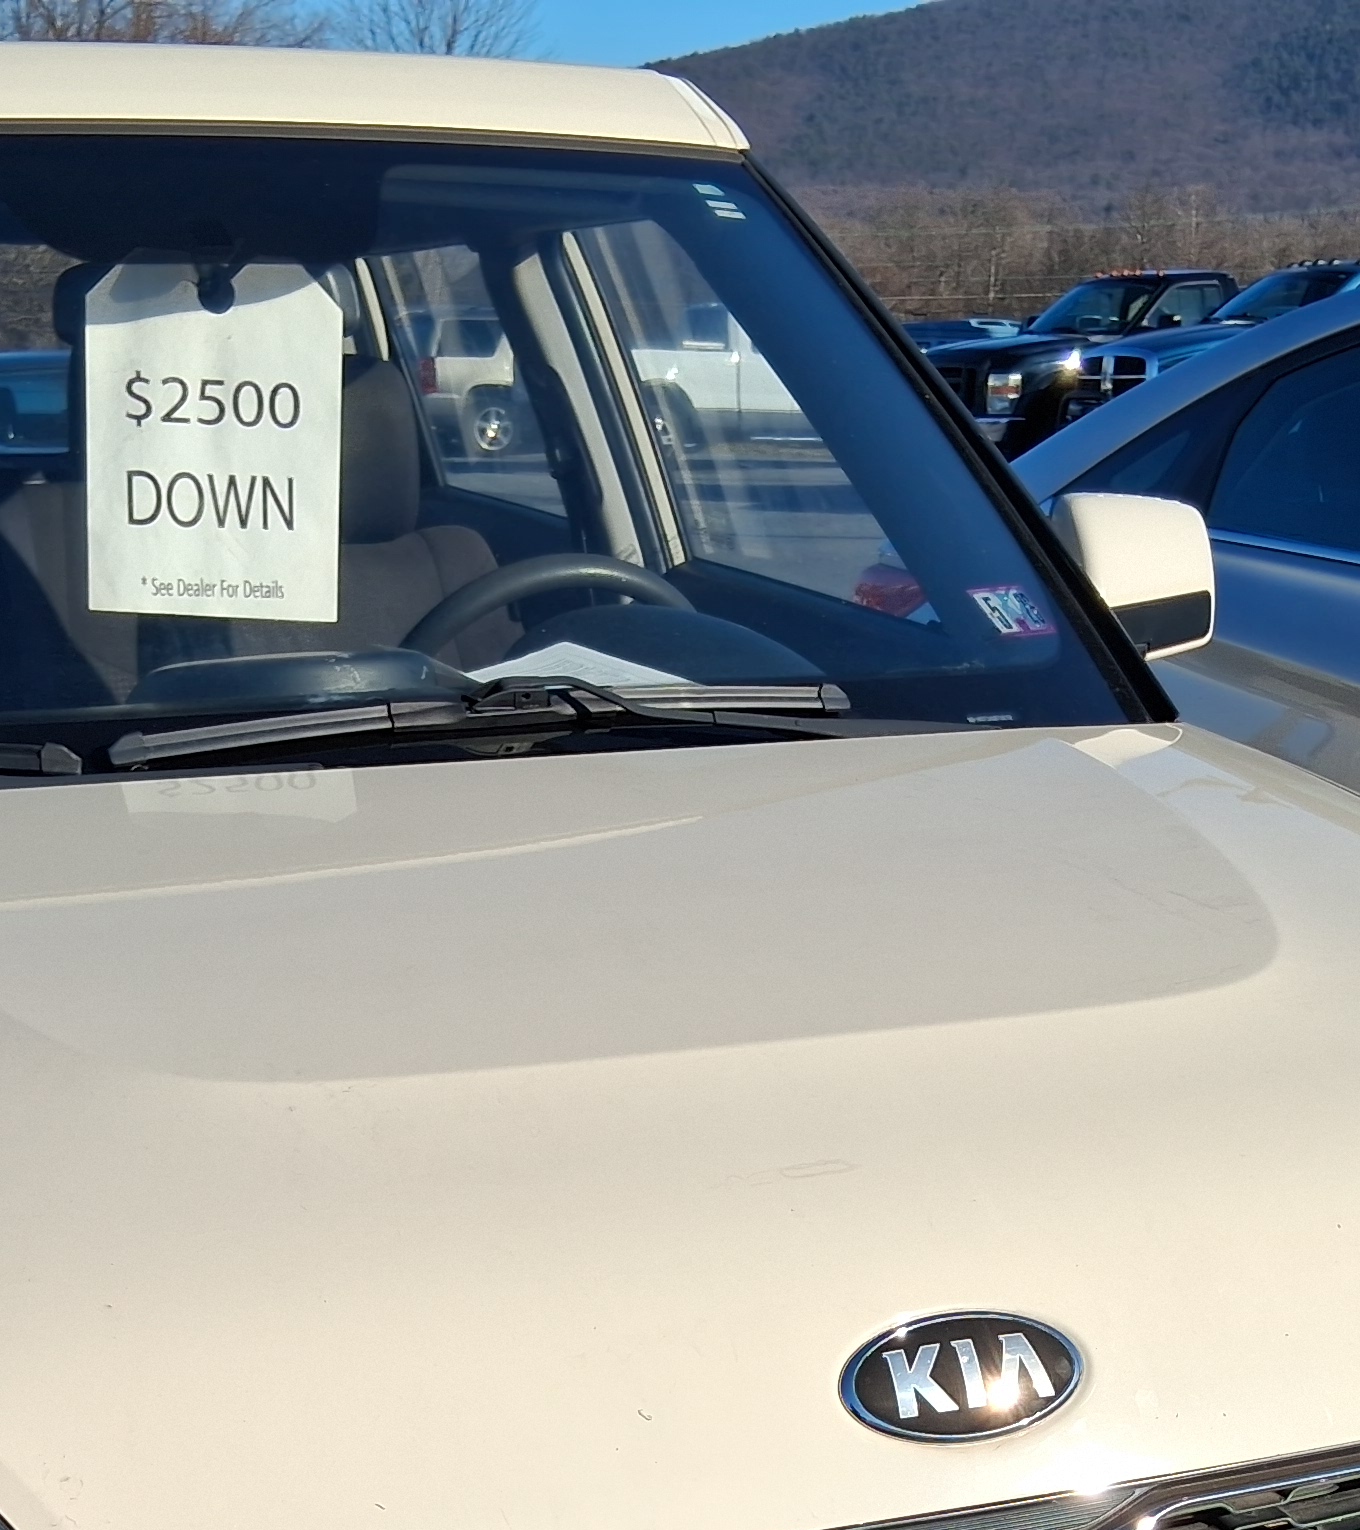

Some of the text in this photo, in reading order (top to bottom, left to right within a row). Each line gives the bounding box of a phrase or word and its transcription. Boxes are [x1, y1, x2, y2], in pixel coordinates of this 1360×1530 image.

[124, 370, 301, 429] $2500
[126, 469, 295, 531] DOWN
[151, 577, 174, 597] See
[177, 577, 217, 598] Dealer
[220, 579, 239, 598] For
[243, 580, 285, 599] Details
[882, 1332, 1056, 1419] KIA
